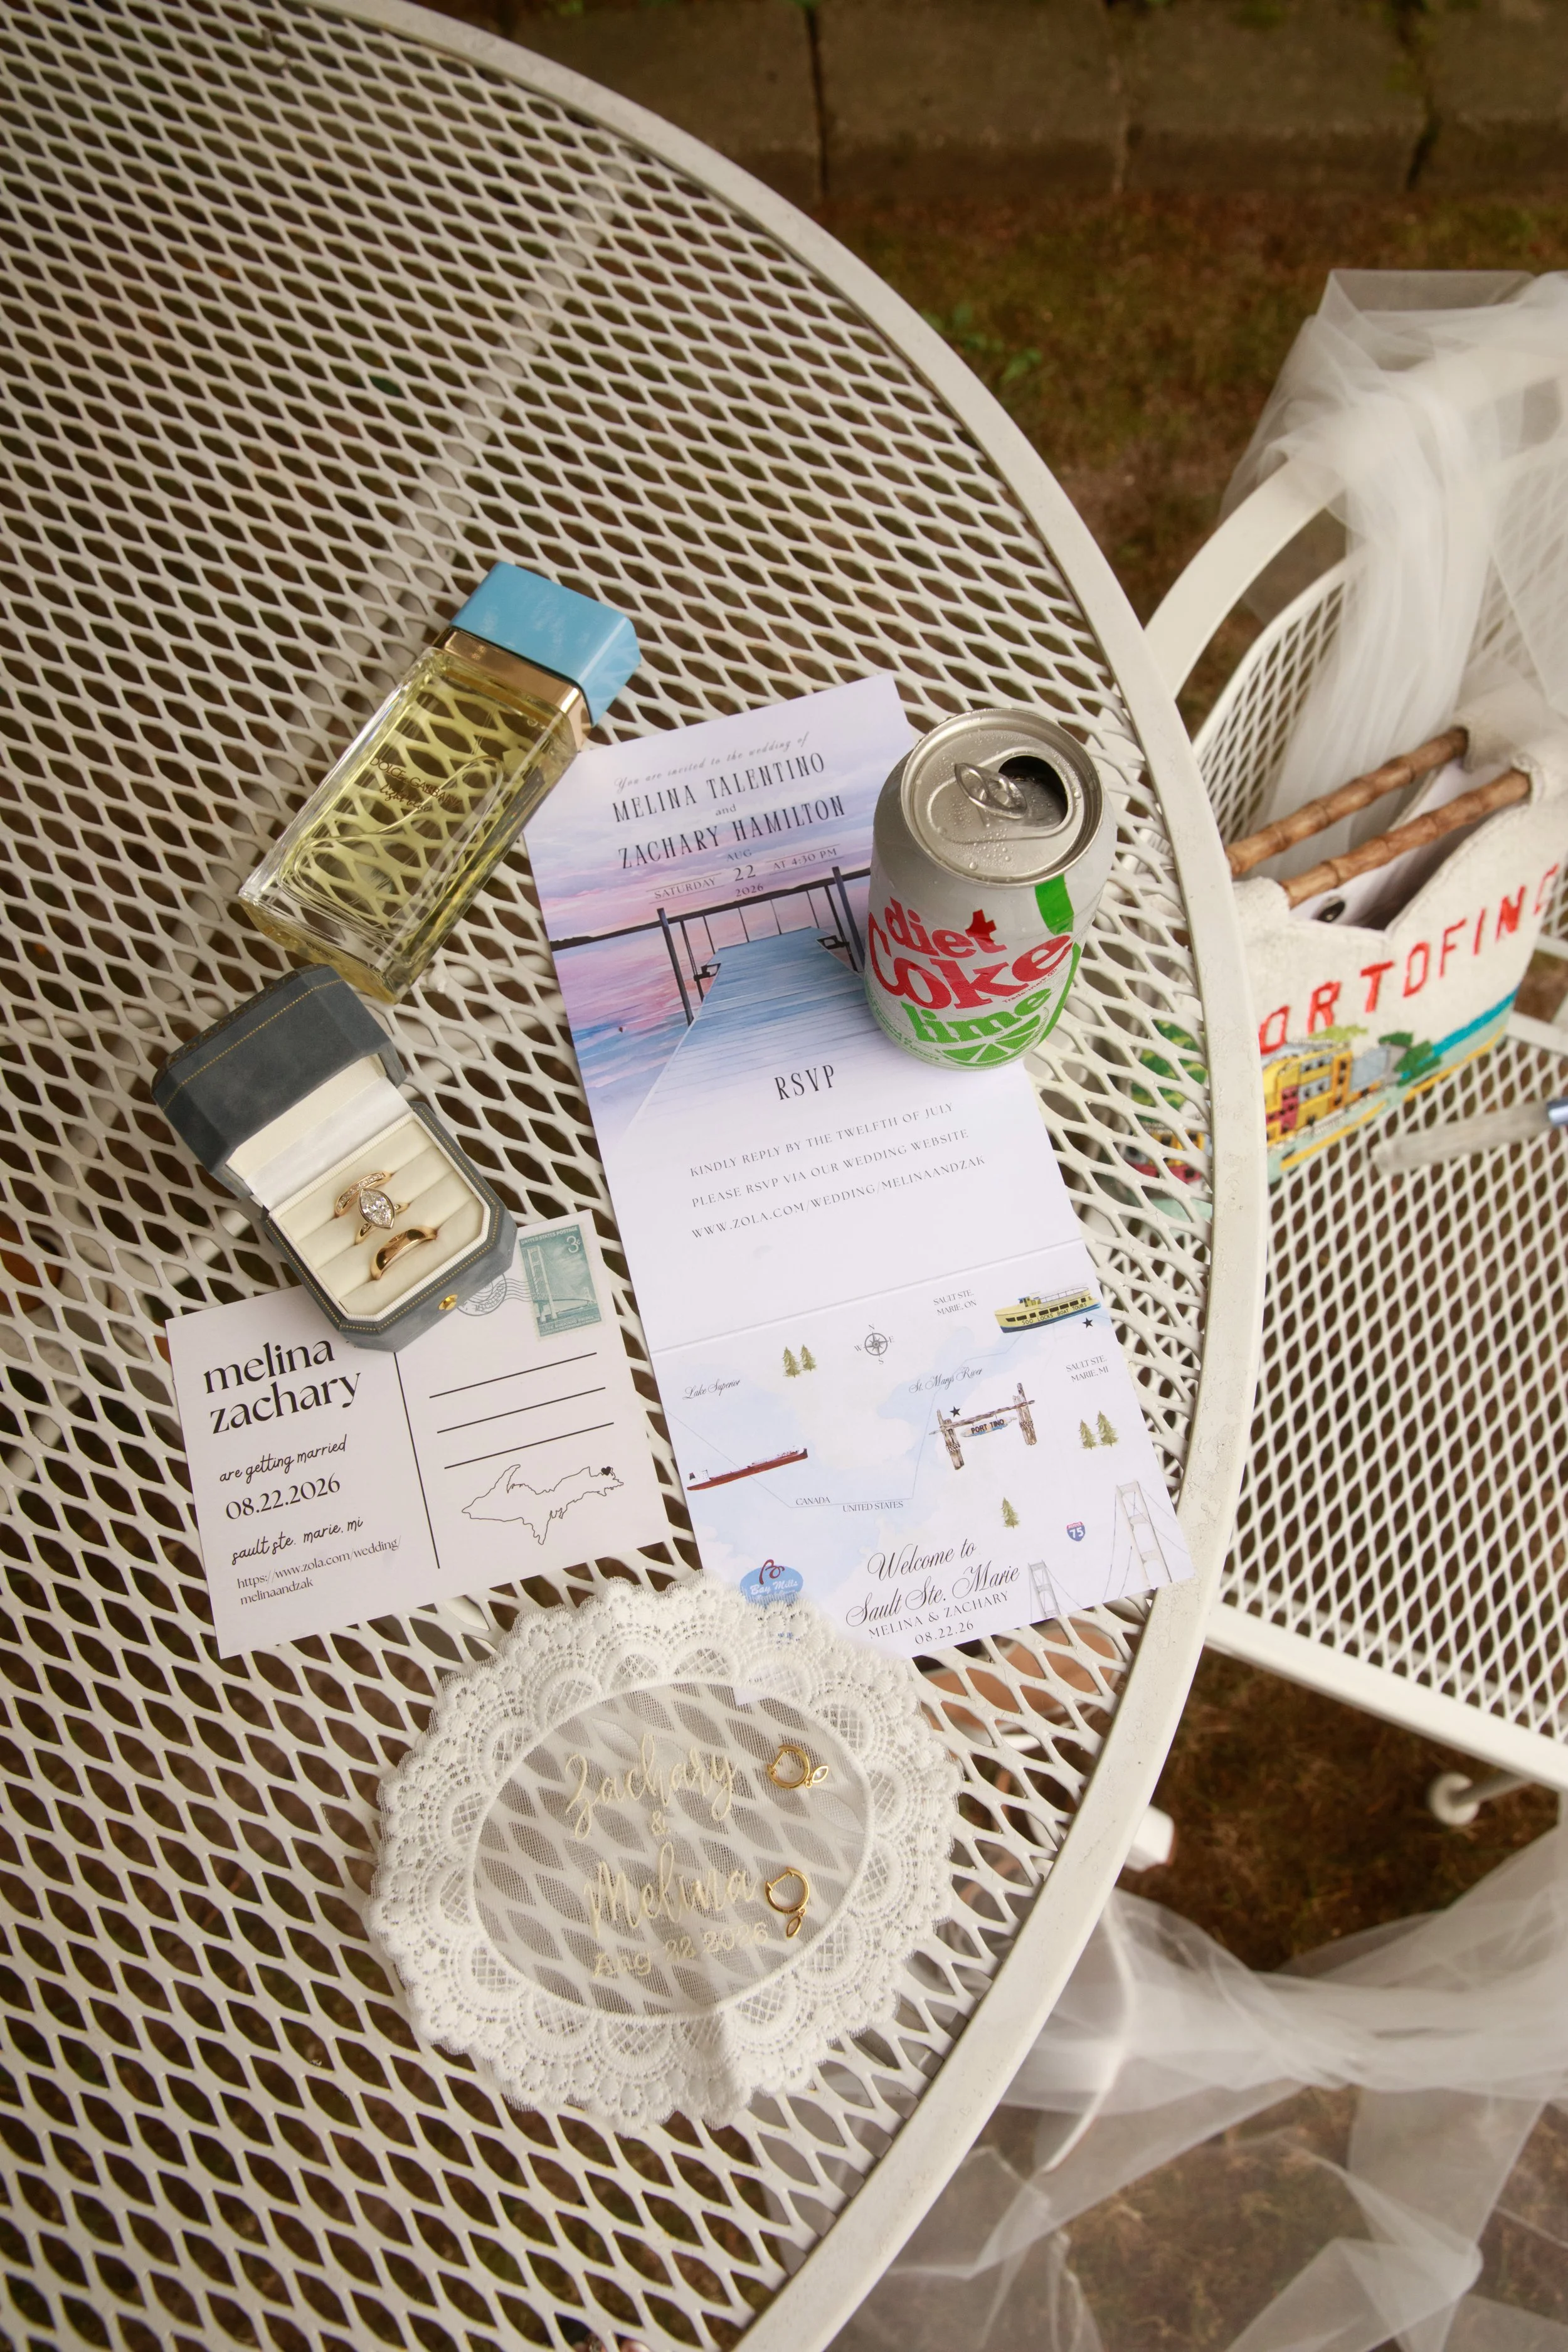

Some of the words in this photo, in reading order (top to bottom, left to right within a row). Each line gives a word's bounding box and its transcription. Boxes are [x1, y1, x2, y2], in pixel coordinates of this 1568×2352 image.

[369, 757, 406, 781] DOLCE
[615, 778, 638, 794] You
[645, 773, 662, 782] are
[667, 758, 706, 776] invited
[726, 750, 743, 761] the
[749, 740, 791, 756] wedding
[797, 731, 809, 747] of
[612, 785, 697, 823] MELINA
[706, 752, 825, 799] TALENTINO
[715, 803, 737, 816] and
[618, 825, 719, 869] ZACHARY
[732, 795, 845, 842] HAMILTON
[654, 877, 716, 899] SATURDAY
[733, 864, 756, 882] 22
[773, 858, 787, 871] AT
[791, 853, 815, 867] 4:30
[820, 847, 837, 860] PM
[726, 849, 753, 862] AUG
[735, 883, 764, 897] 2026
[884, 896, 1007, 959] diet
[868, 912, 1073, 1009] Coke
[1259, 862, 1560, 1055] ORTOFIN
[901, 988, 1052, 1044] lime
[774, 1064, 835, 1100] RSVP
[690, 1157, 737, 1177] KINDLY
[743, 1147, 781, 1165] REPLY
[786, 1141, 802, 1153] BY
[805, 1133, 832, 1148] THE
[836, 1116, 898, 1140] TWELFTH
[903, 1111, 920, 1123] OF
[924, 1103, 954, 1120] JULY
[692, 1188, 741, 1207] PLEASE
[746, 1178, 779, 1194] RSVP
[783, 1172, 807, 1184] VIA
[811, 1163, 839, 1178] OUR
[842, 1145, 908, 1168] WEDDING
[911, 1130, 969, 1151] WEBSITE
[692, 1155, 986, 1239] WWW.ZOLA.COM/WEDDING/MELINAANDZAK
[521, 1237, 539, 1245] UNITED
[556, 1226, 578, 1236] POSTAGE
[933, 1293, 955, 1305] SAULT
[958, 1290, 974, 1299] STE.
[965, 1300, 977, 1308] ON
[1037, 1313, 1053, 1322] LOCKS
[1057, 1308, 1069, 1316] BOAT
[1072, 1302, 1087, 1311] TOURS
[203, 1340, 336, 1394] melina
[909, 1379, 923, 1393] St.
[956, 1367, 983, 1381] River
[1066, 1359, 1088, 1372] SAULT
[1090, 1355, 1108, 1365] STE.
[1098, 1365, 1109, 1374] MI
[210, 1372, 361, 1434] zachary
[682, 1384, 707, 1399] Lake
[707, 1379, 740, 1396] Superior
[970, 1424, 988, 1434] PORT
[990, 1419, 1004, 1429] TINO
[220, 1468, 243, 1482] are
[246, 1454, 295, 1484] getting
[297, 1434, 347, 1463] married
[226, 1472, 341, 1519] 08.22.2026
[796, 1496, 830, 1506] CANADA
[842, 1503, 873, 1512] UNITED
[874, 1501, 903, 1510] STATES
[232, 1536, 270, 1565] sault
[272, 1531, 296, 1555] ste.
[347, 1517, 363, 1531] mi
[1069, 1527, 1084, 1539] 75
[238, 1535, 402, 1589] https://www.zola.com/wedding/
[867, 1543, 955, 1581] Welcome
[960, 1539, 977, 1559] to
[240, 1577, 314, 1605] melinaandzak
[750, 1584, 771, 1595] Bay
[772, 1579, 798, 1590] Mills
[846, 1587, 902, 1627] Sault
[905, 1576, 946, 1610] Ste.
[952, 1560, 1020, 1599] Marie
[869, 1616, 923, 1639] MELINA
[928, 1611, 939, 1623] &
[943, 1590, 1009, 1618] ZACHARY
[915, 1619, 973, 1645] 08.22.26
[566, 1734, 738, 1840] Zachary
[651, 1810, 670, 1836] &
[583, 1841, 758, 1939] Melina
